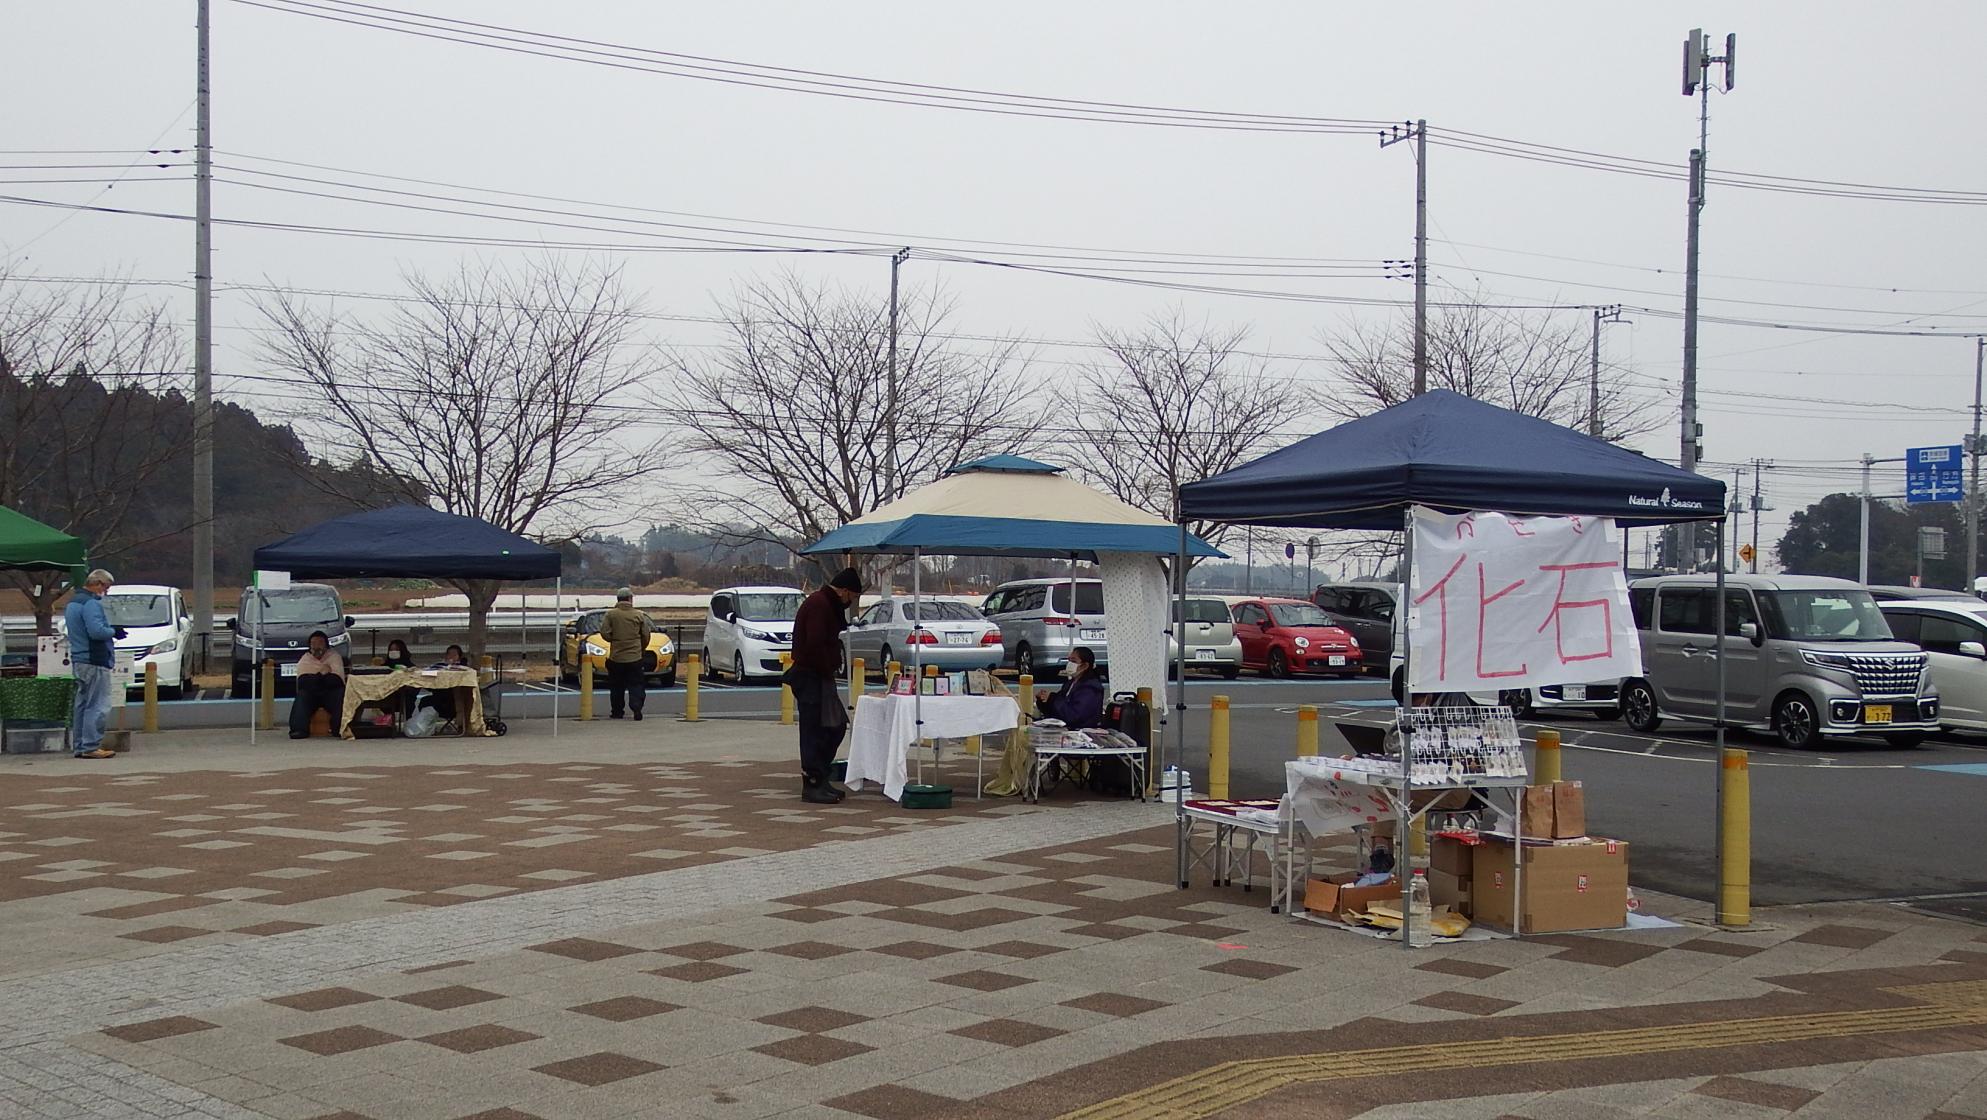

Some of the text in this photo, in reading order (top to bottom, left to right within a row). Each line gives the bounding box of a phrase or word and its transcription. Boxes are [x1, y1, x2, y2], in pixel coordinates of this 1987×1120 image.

[1628, 494, 1703, 508] Natural Season
[1414, 553, 1619, 682] 化石
